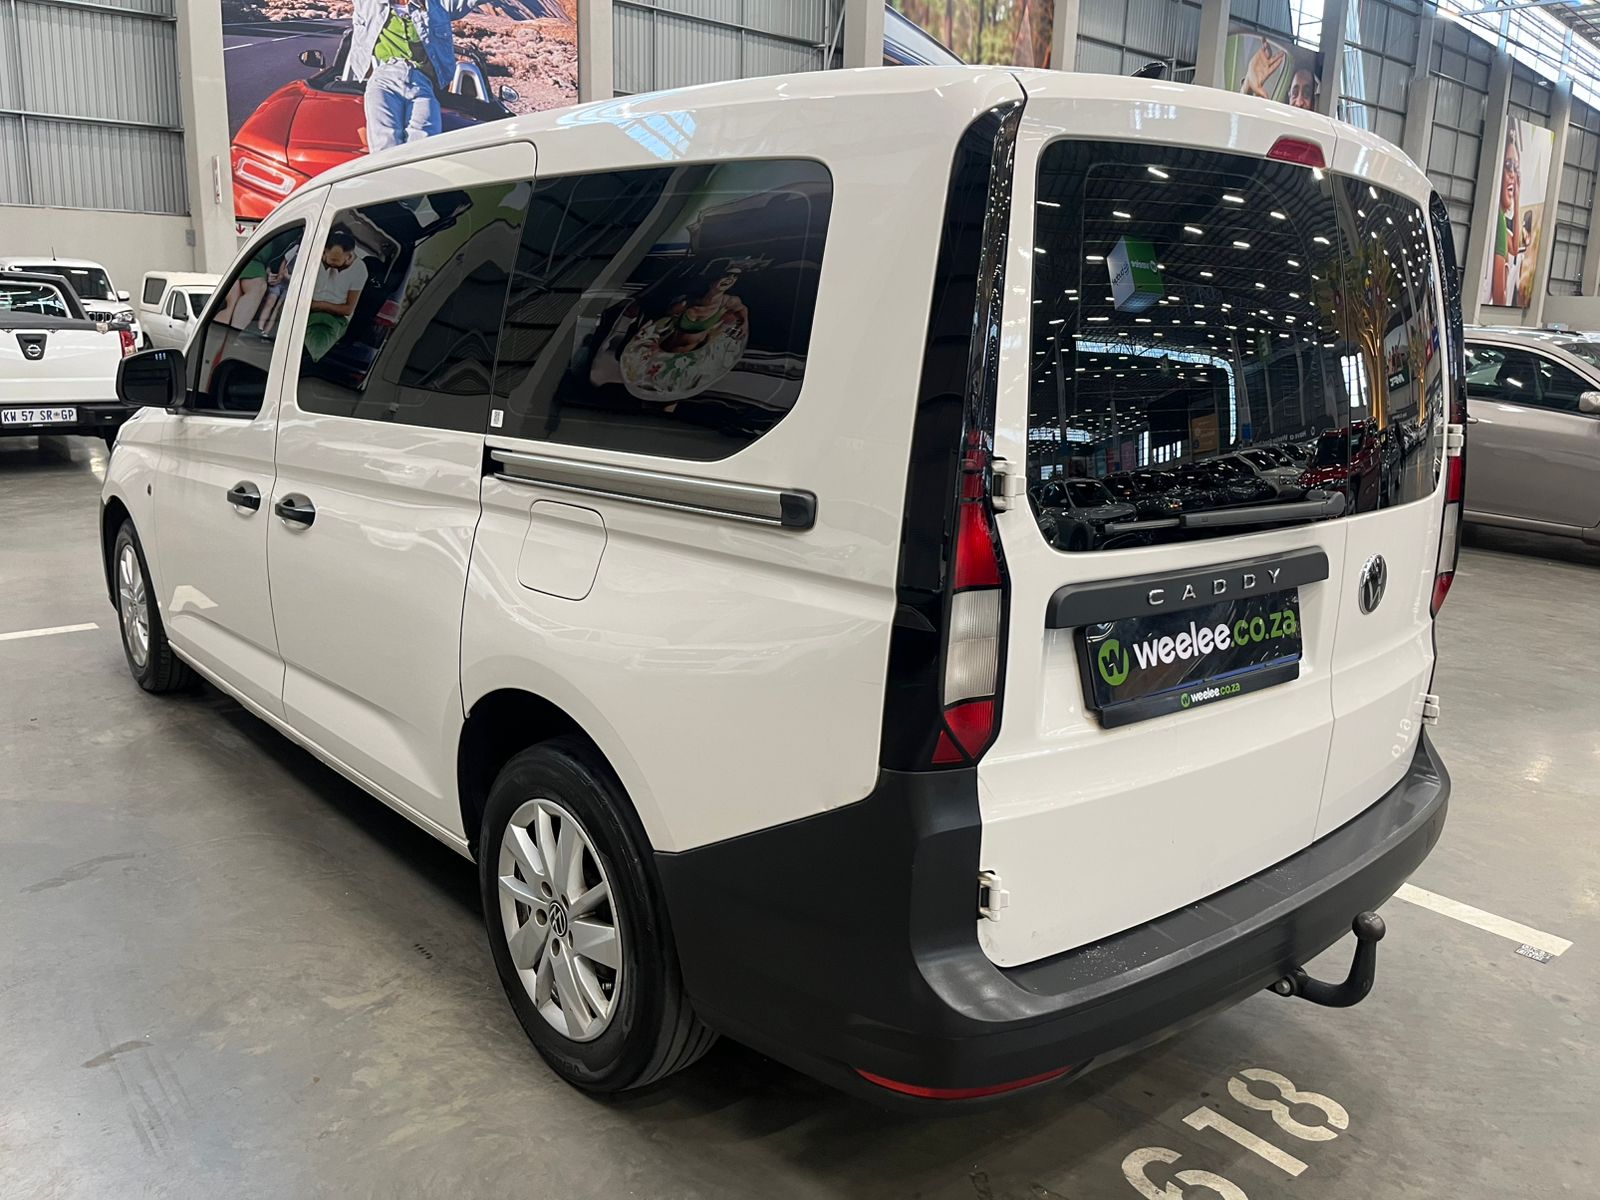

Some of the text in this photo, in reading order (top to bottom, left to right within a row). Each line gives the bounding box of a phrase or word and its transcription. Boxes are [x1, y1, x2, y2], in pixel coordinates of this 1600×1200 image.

[3, 409, 74, 422] KW 57 SR GP
[1148, 568, 1281, 606] CADDY
[1133, 609, 1297, 670] weelee.co.za
[1190, 682, 1241, 703] weelee.co.za
[1121, 1068, 1350, 1200] 618
